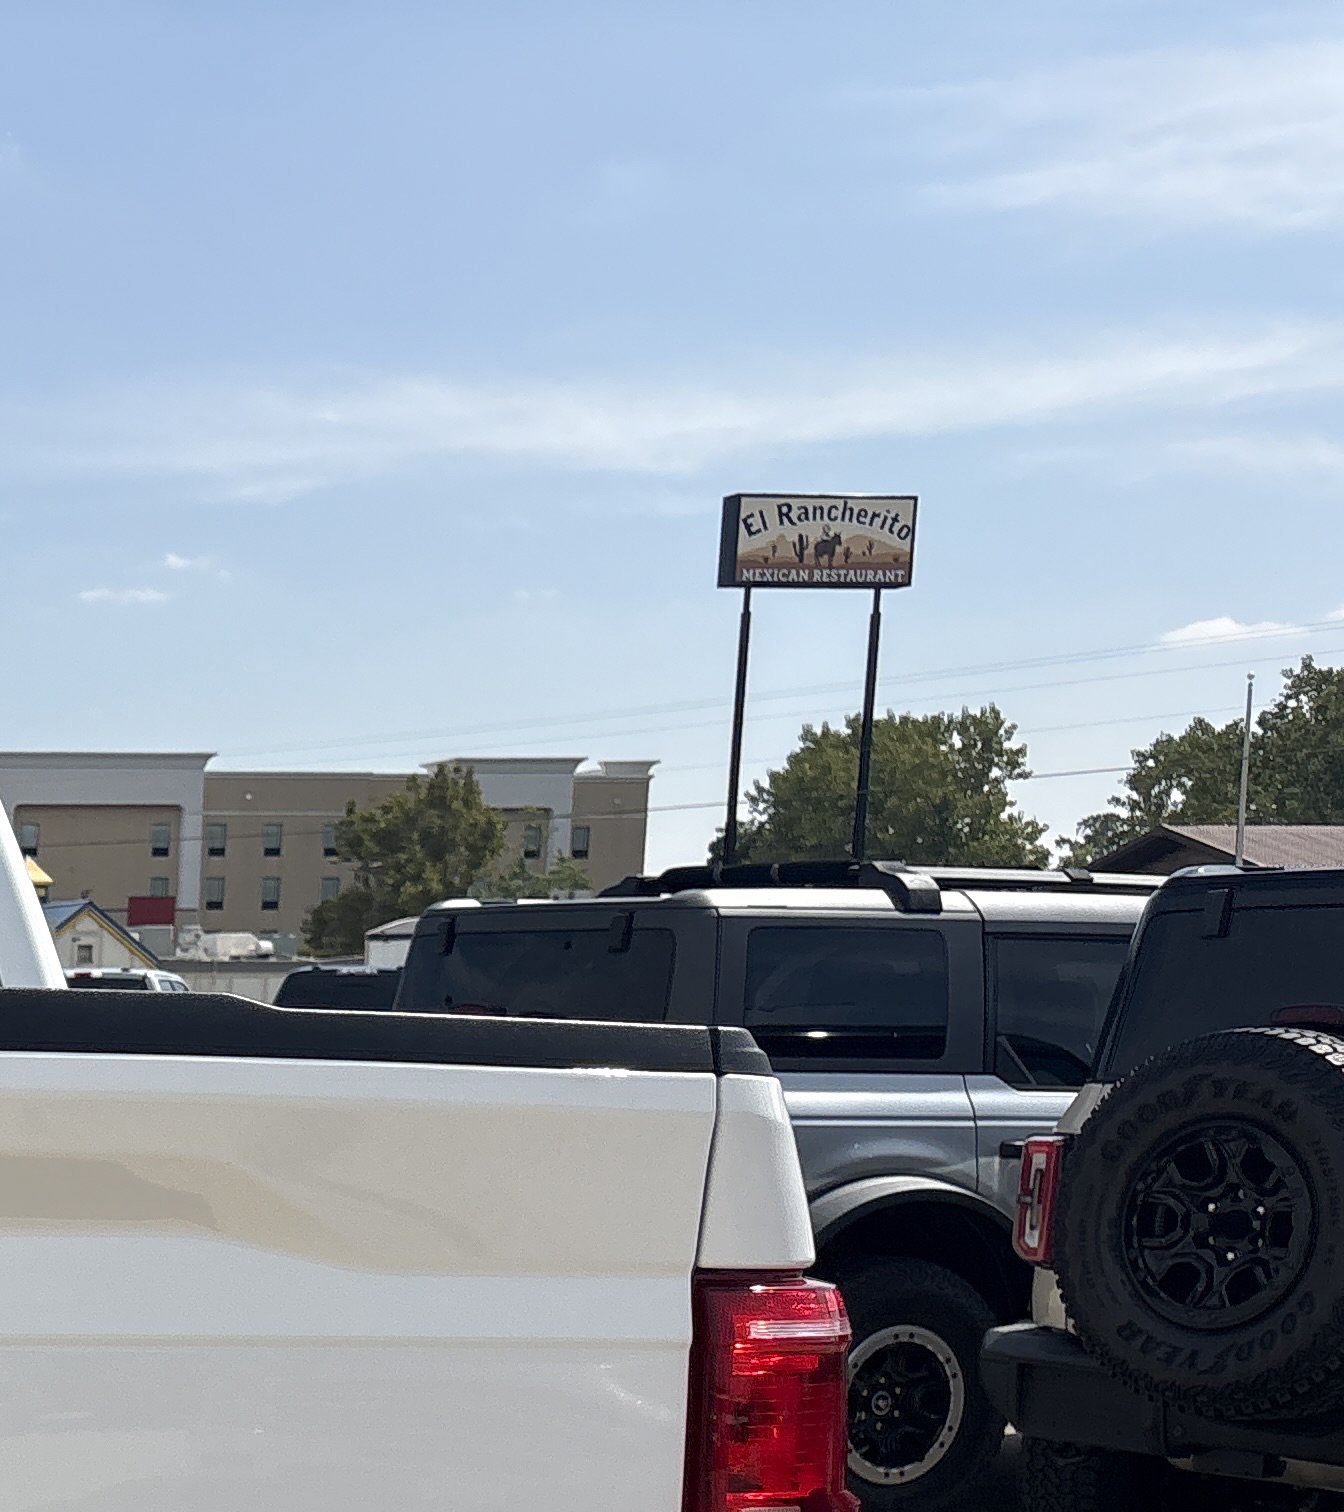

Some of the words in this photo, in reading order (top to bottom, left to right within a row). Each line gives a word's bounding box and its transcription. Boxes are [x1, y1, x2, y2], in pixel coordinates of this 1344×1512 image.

[741, 509, 769, 538] El
[776, 500, 912, 541] Rancherito
[741, 568, 809, 583] MEXICAN
[813, 569, 906, 584] RESTAURANT
